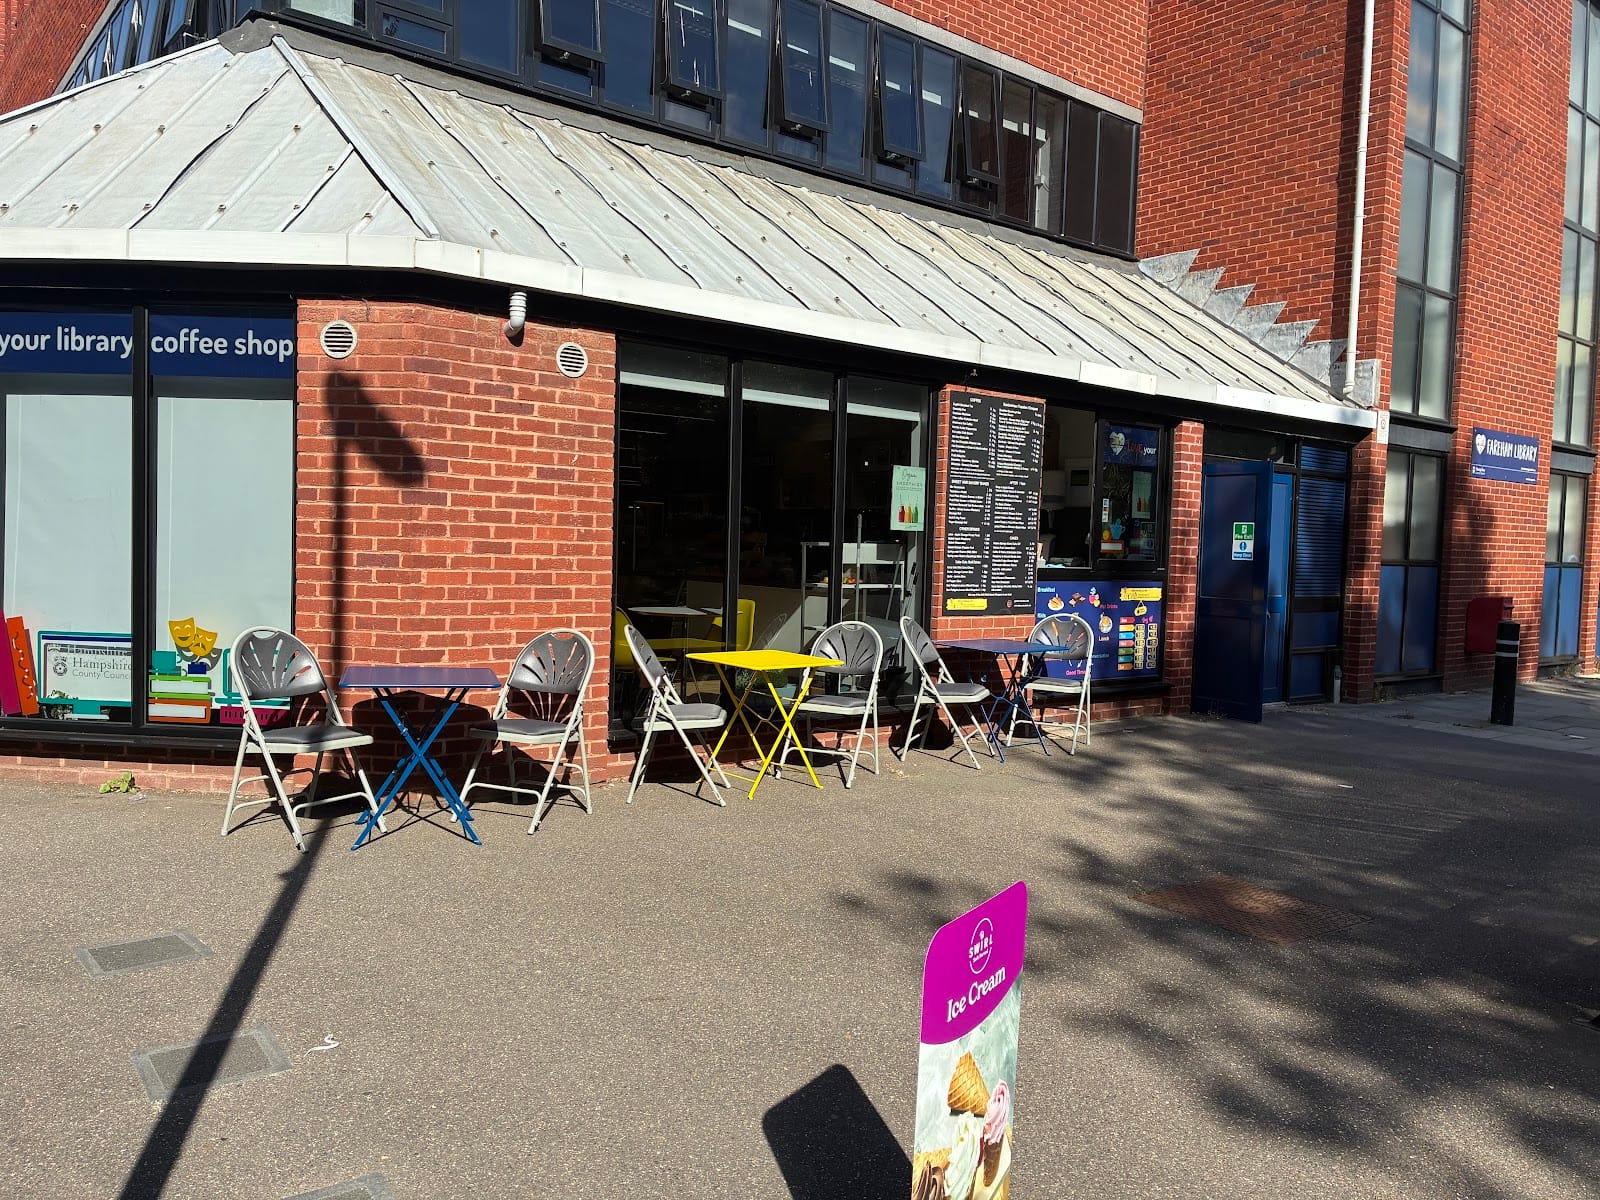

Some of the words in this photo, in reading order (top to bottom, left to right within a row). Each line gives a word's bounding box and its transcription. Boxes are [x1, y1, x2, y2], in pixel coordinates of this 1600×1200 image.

[0, 333, 50, 357] your
[57, 326, 133, 359] library
[151, 328, 228, 355] coffee
[234, 330, 294, 362] shop
[1143, 446, 1157, 456] your
[1486, 439, 1513, 458] FAREHAM
[1513, 443, 1538, 463] LIBRARY
[72, 670, 101, 680] County
[103, 671, 129, 680] Counc
[968, 931, 993, 959] SWIRL
[946, 996, 967, 1023] Ice
[968, 966, 1006, 1006] Cream
